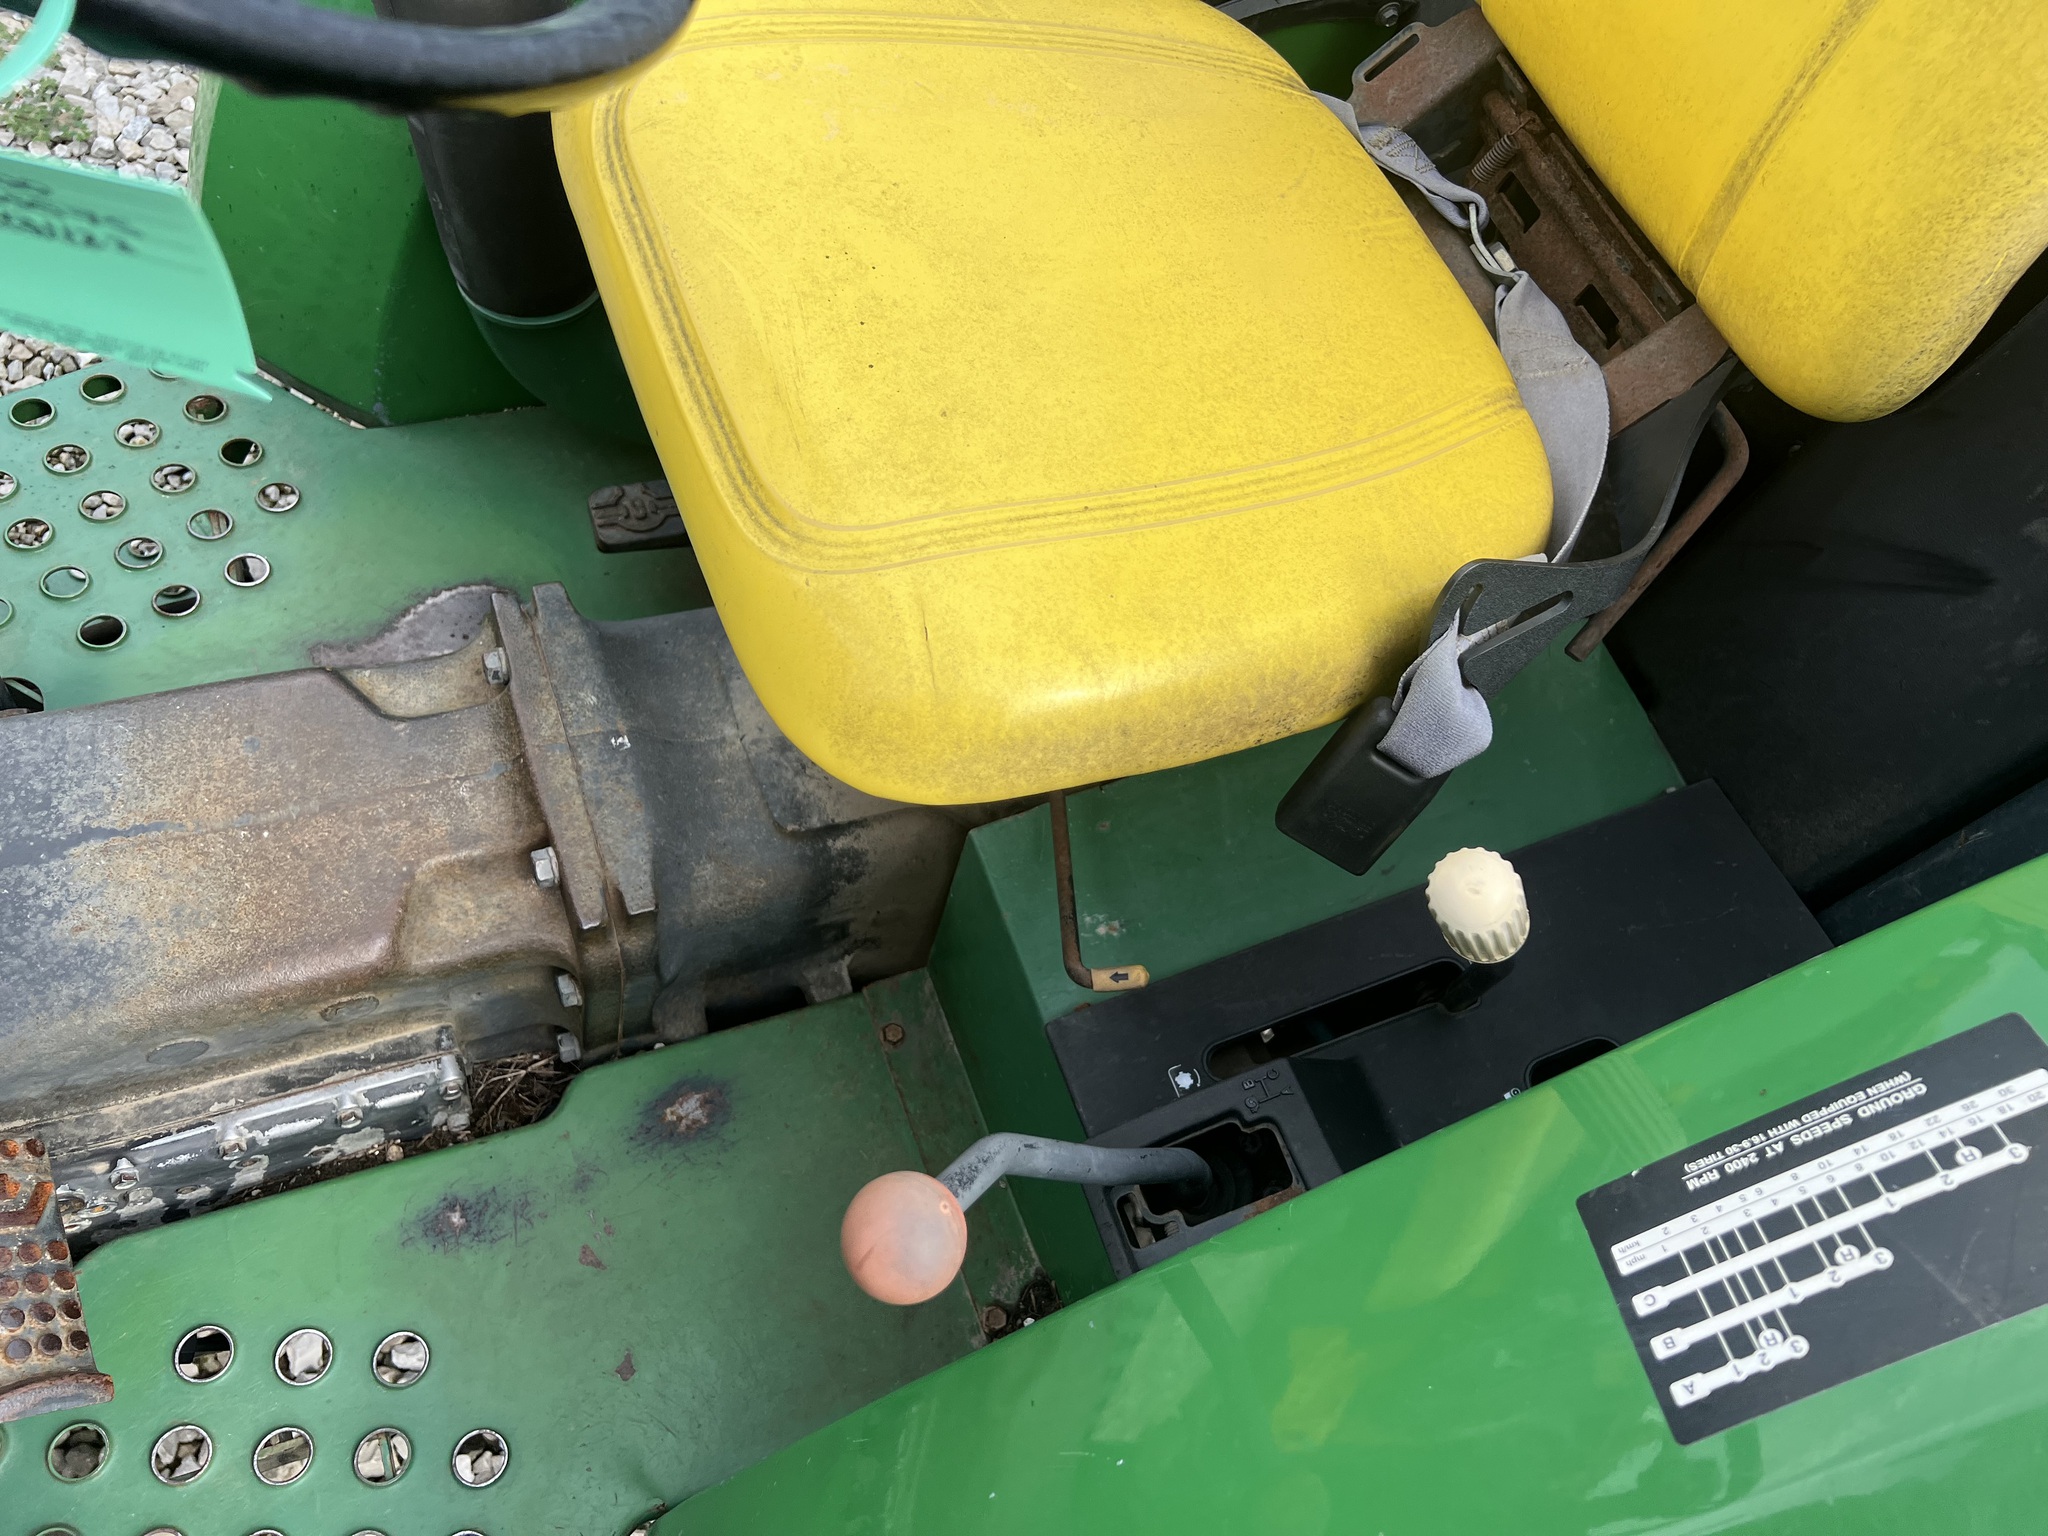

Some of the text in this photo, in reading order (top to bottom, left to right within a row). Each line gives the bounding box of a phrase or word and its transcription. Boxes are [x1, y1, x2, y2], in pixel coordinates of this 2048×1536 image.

[1683, 1070, 1911, 1172] (WHEN EQUIPPED WITH 16.9-30 TIRES)
[1923, 1114, 1941, 1126] 22
[1685, 1083, 1926, 1190] GROUND SPEEDS AT 2400 RPM
[1938, 1127, 1954, 1138] 14
[1852, 1144, 1868, 1155] 14
[1907, 1138, 1925, 1150] 12
[1878, 1150, 1896, 1161] 10
[1960, 1149, 1977, 1162] R
[1816, 1159, 1833, 1169] 10
[1789, 1172, 1798, 1181] 8
[1825, 1174, 1835, 1183] 6
[1754, 1186, 1763, 1196] 6
[1797, 1185, 1807, 1194] 5
[1738, 1193, 1747, 1202] 5
[1769, 1197, 1778, 1206] 4
[1714, 1203, 1723, 1213] 4
[1742, 1208, 1751, 1217] 3
[1689, 1214, 1699, 1223] 3
[1643, 1146, 2022, 1306] 3 2 1 C
[1660, 1226, 1670, 1235] 2
[1699, 1225, 1709, 1235] 2
[1617, 1240, 1641, 1253] km/h
[1625, 1253, 1646, 1266] mph
[1839, 1247, 1855, 1262] R
[1662, 1251, 1887, 1349] 3 2 1 B
[1762, 1332, 1778, 1346] R
[1682, 1339, 1803, 1395] 3 2 1 A
